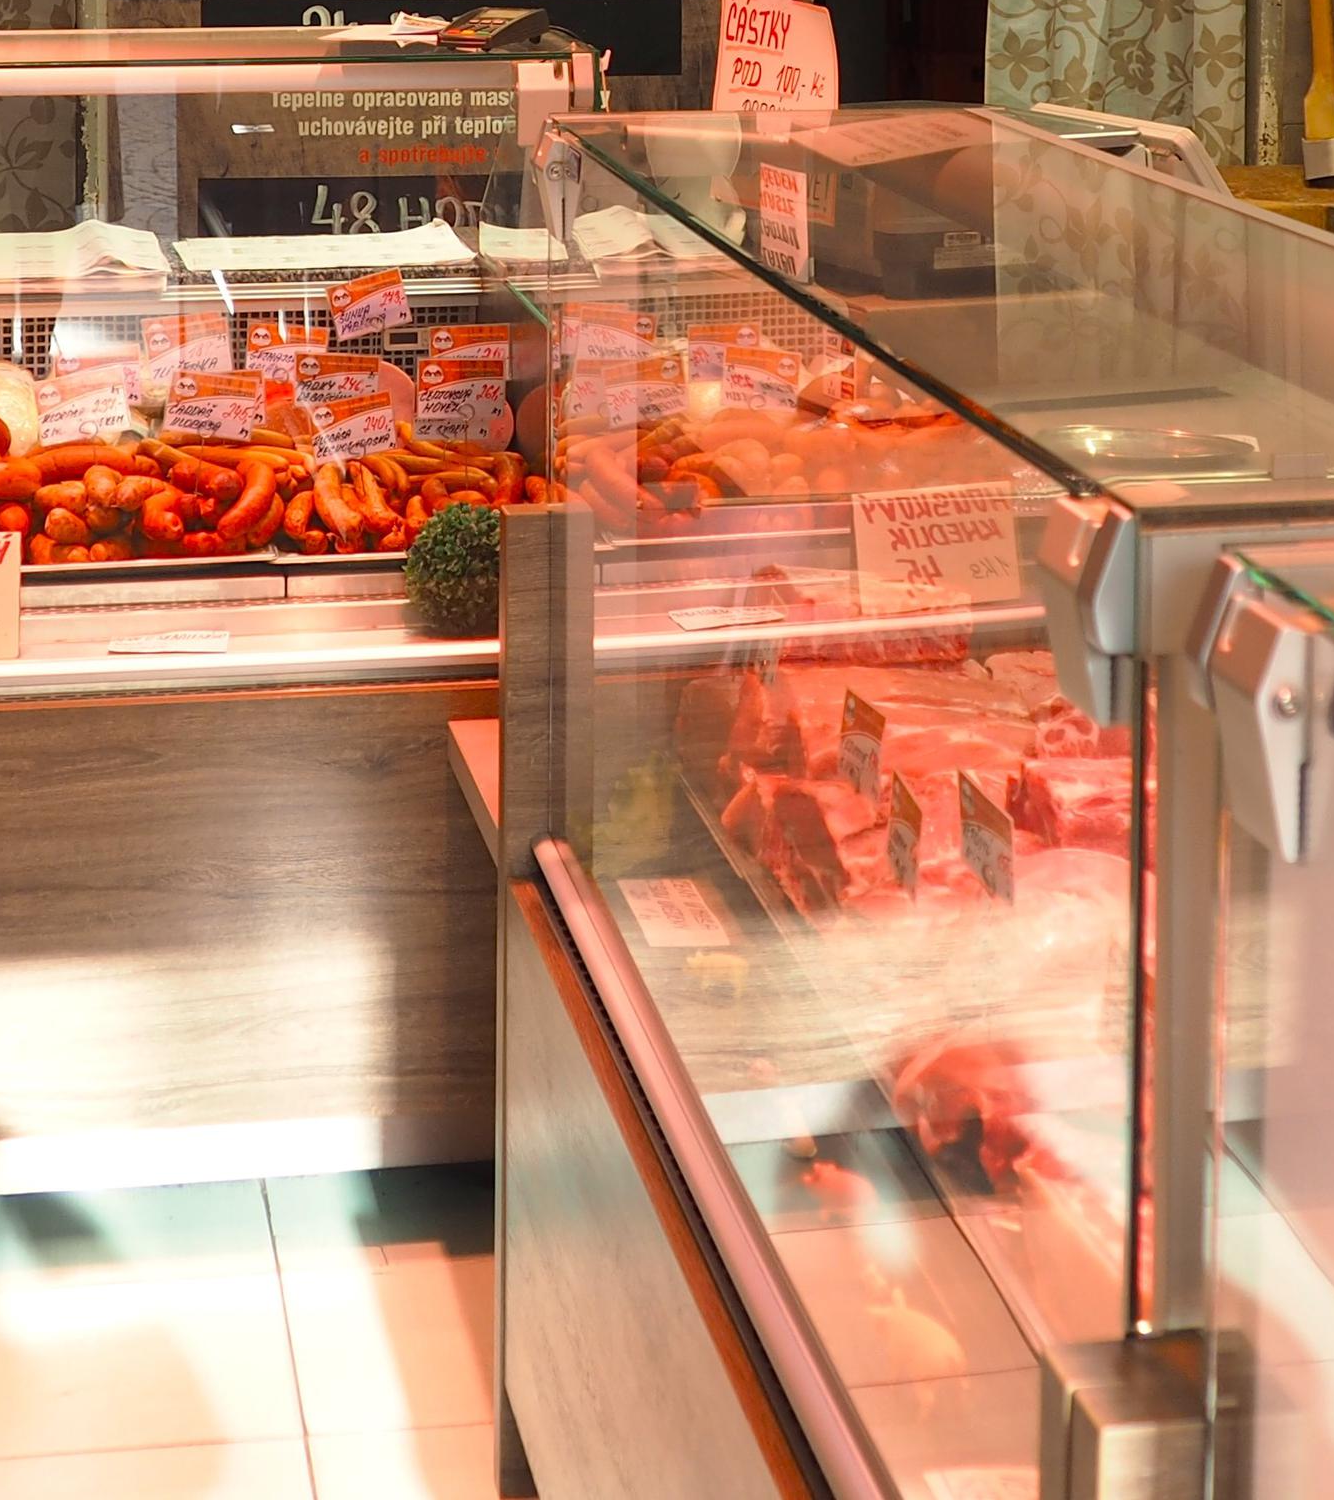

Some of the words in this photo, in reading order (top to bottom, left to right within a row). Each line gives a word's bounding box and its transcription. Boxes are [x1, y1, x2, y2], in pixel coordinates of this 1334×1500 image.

[731, 57, 763, 88] POD
[298, 115, 414, 140] uchovávejte
[421, 115, 447, 140] při
[358, 150, 371, 164] a
[378, 144, 487, 166] spotřebujte
